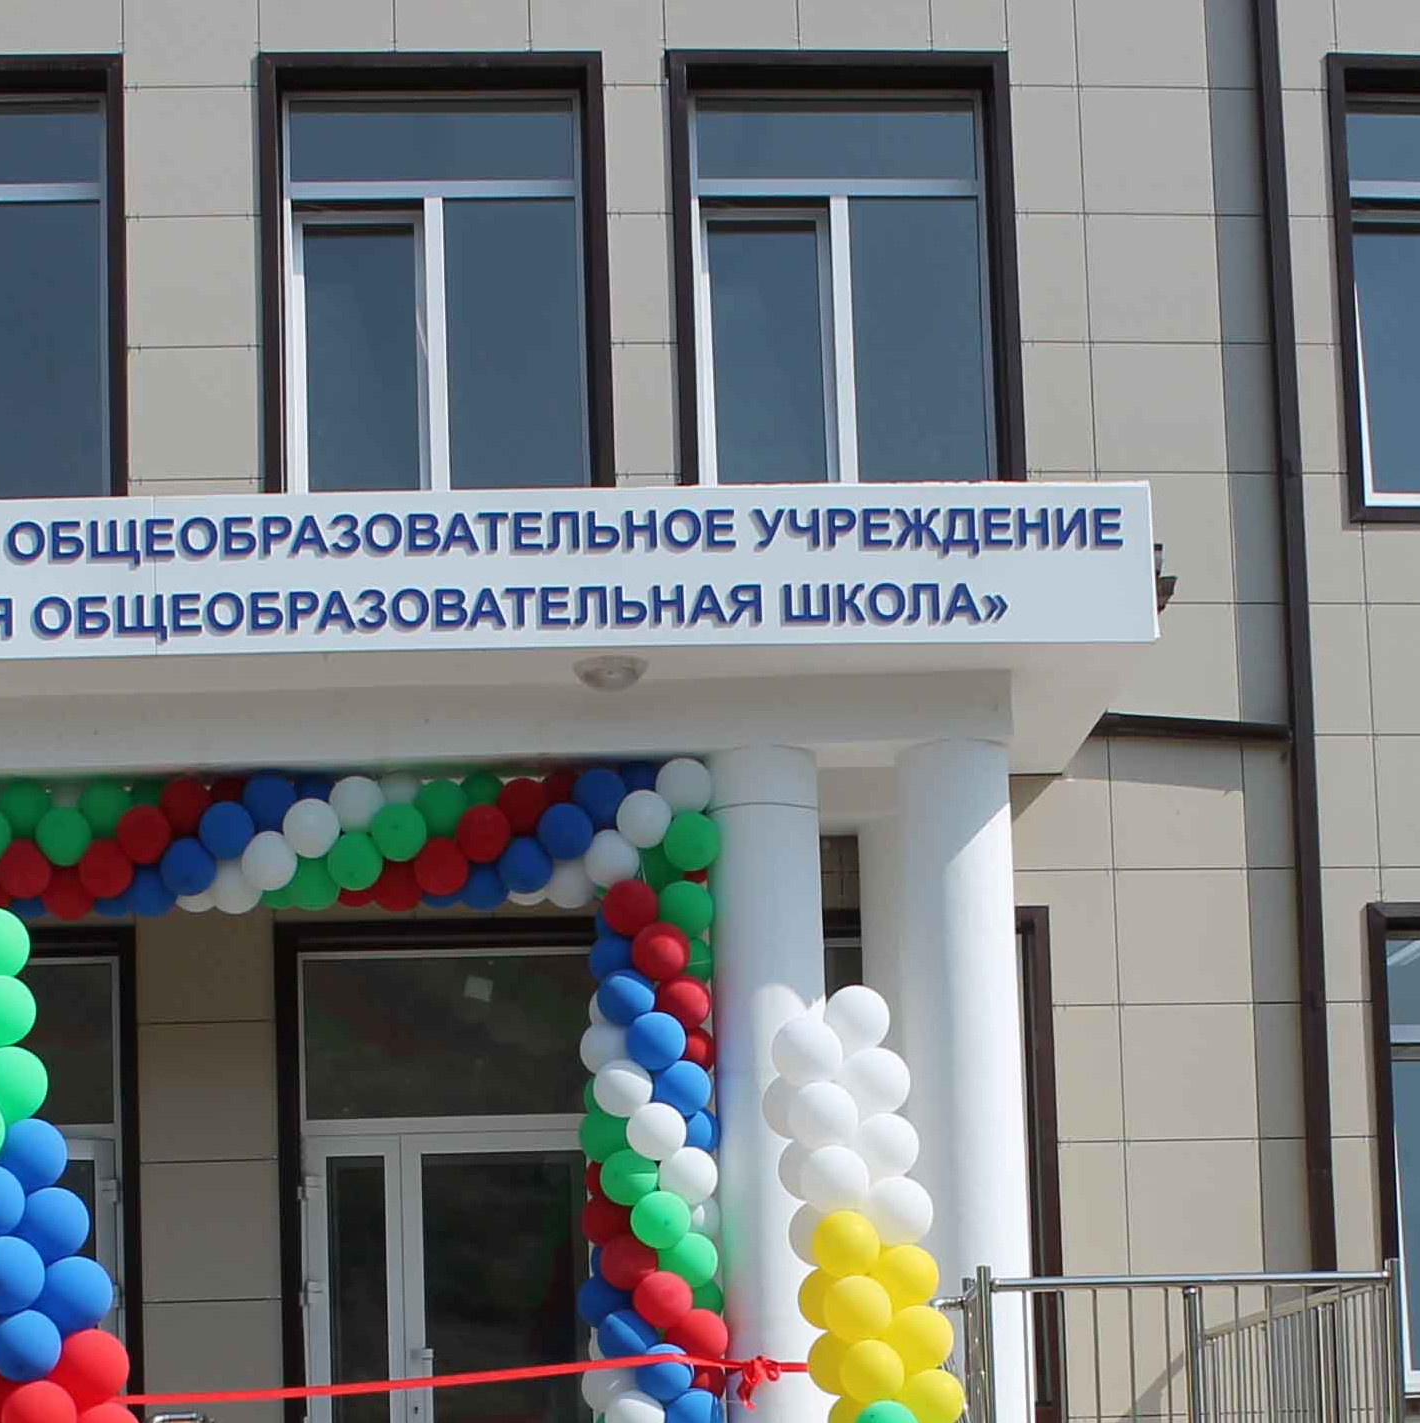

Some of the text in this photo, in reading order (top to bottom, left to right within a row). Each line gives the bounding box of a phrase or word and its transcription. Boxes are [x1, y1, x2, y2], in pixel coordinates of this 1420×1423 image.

[4, 508, 735, 561] ОБЩЕОБРАЗОВАТЕЛЬНОЕ
[753, 507, 1124, 553] УЧРЕЖДЕНИЕ
[32, 583, 762, 639] ОБЩЕОБРАЗОВАТЕЛЬНАЯ
[783, 582, 1007, 621] ШКОЛА»
